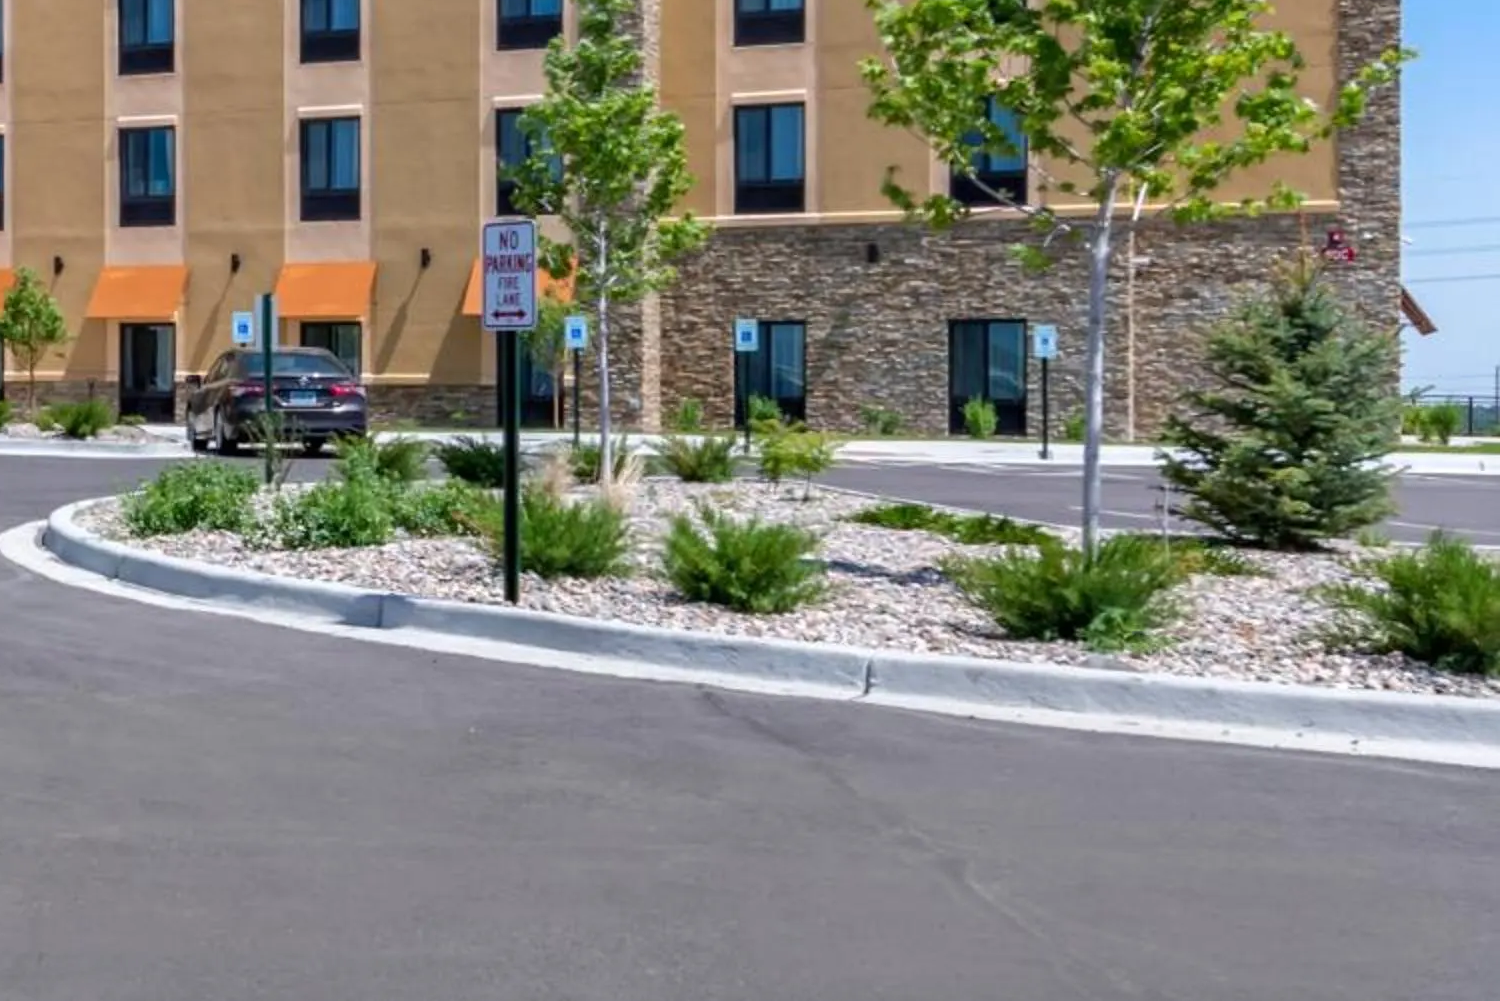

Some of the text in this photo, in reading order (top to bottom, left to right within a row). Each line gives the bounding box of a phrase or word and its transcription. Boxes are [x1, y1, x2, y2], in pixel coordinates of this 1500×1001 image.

[499, 230, 519, 249] NO
[484, 254, 533, 273] PARKING
[498, 276, 519, 290] FIRE
[496, 292, 522, 307] LANE
